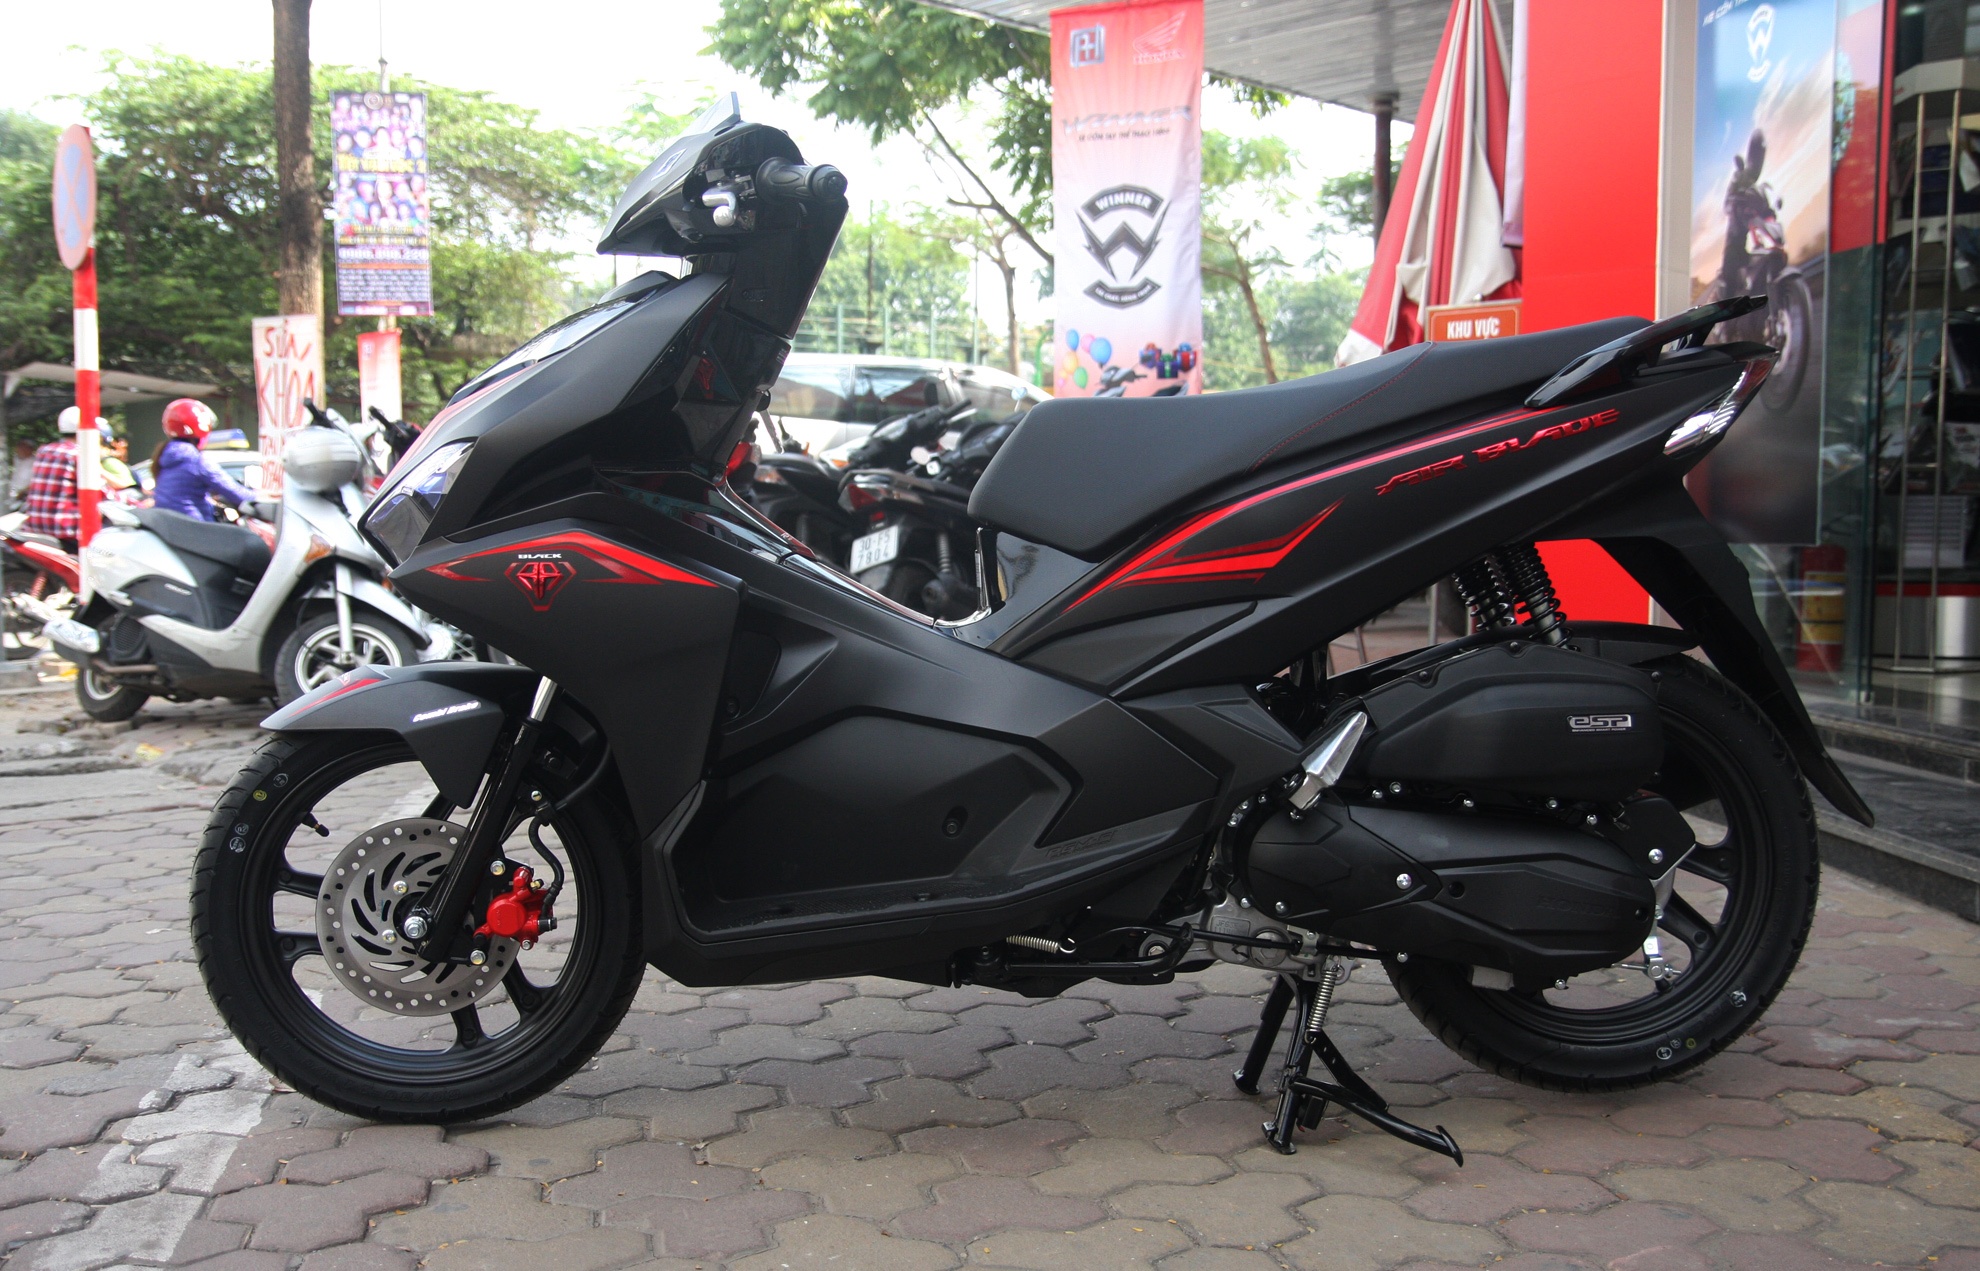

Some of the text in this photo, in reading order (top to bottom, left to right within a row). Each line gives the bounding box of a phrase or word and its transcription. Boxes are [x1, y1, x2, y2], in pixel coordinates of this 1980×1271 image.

[1094, 192, 1153, 211] WINNER
[1446, 316, 1500, 340] KHU VỰC
[1374, 408, 1620, 496] AIR BLADE
[857, 545, 889, 569] 7804
